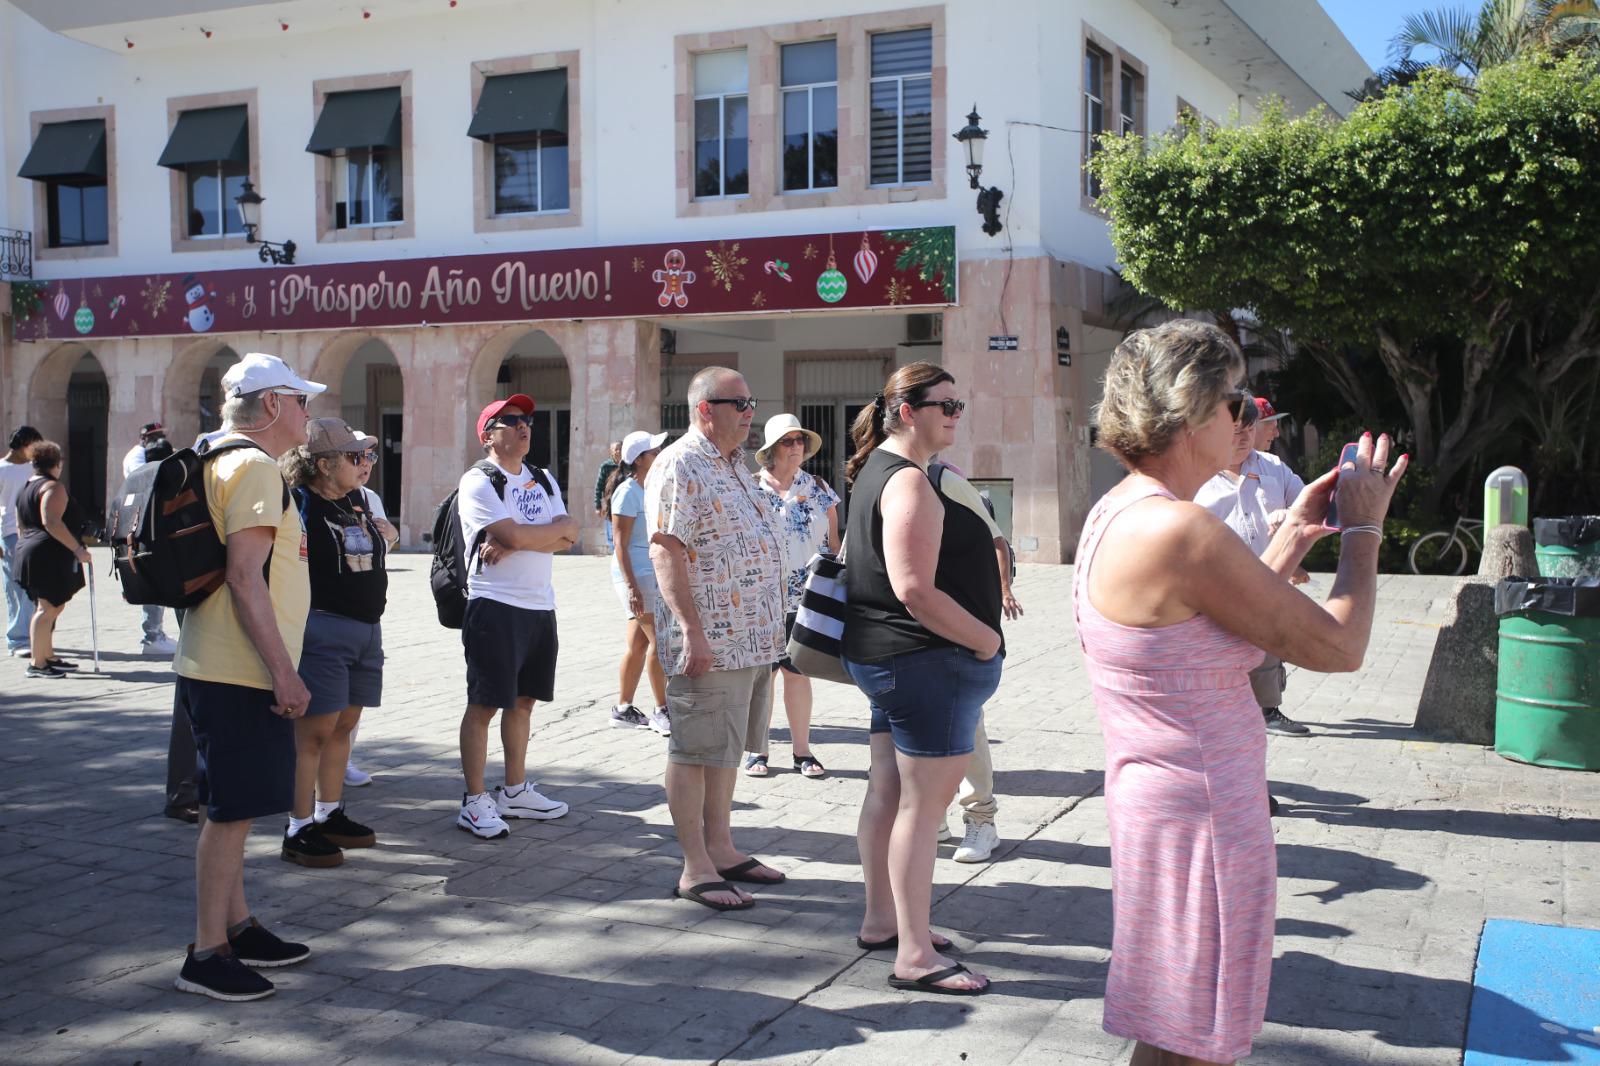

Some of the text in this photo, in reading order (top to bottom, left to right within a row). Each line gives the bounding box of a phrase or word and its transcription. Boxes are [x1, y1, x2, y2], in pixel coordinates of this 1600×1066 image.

[243, 260, 611, 323] y ¡Próspero Año Nuevo!
[512, 488, 543, 504] Calvin
[518, 502, 542, 518] Klein
